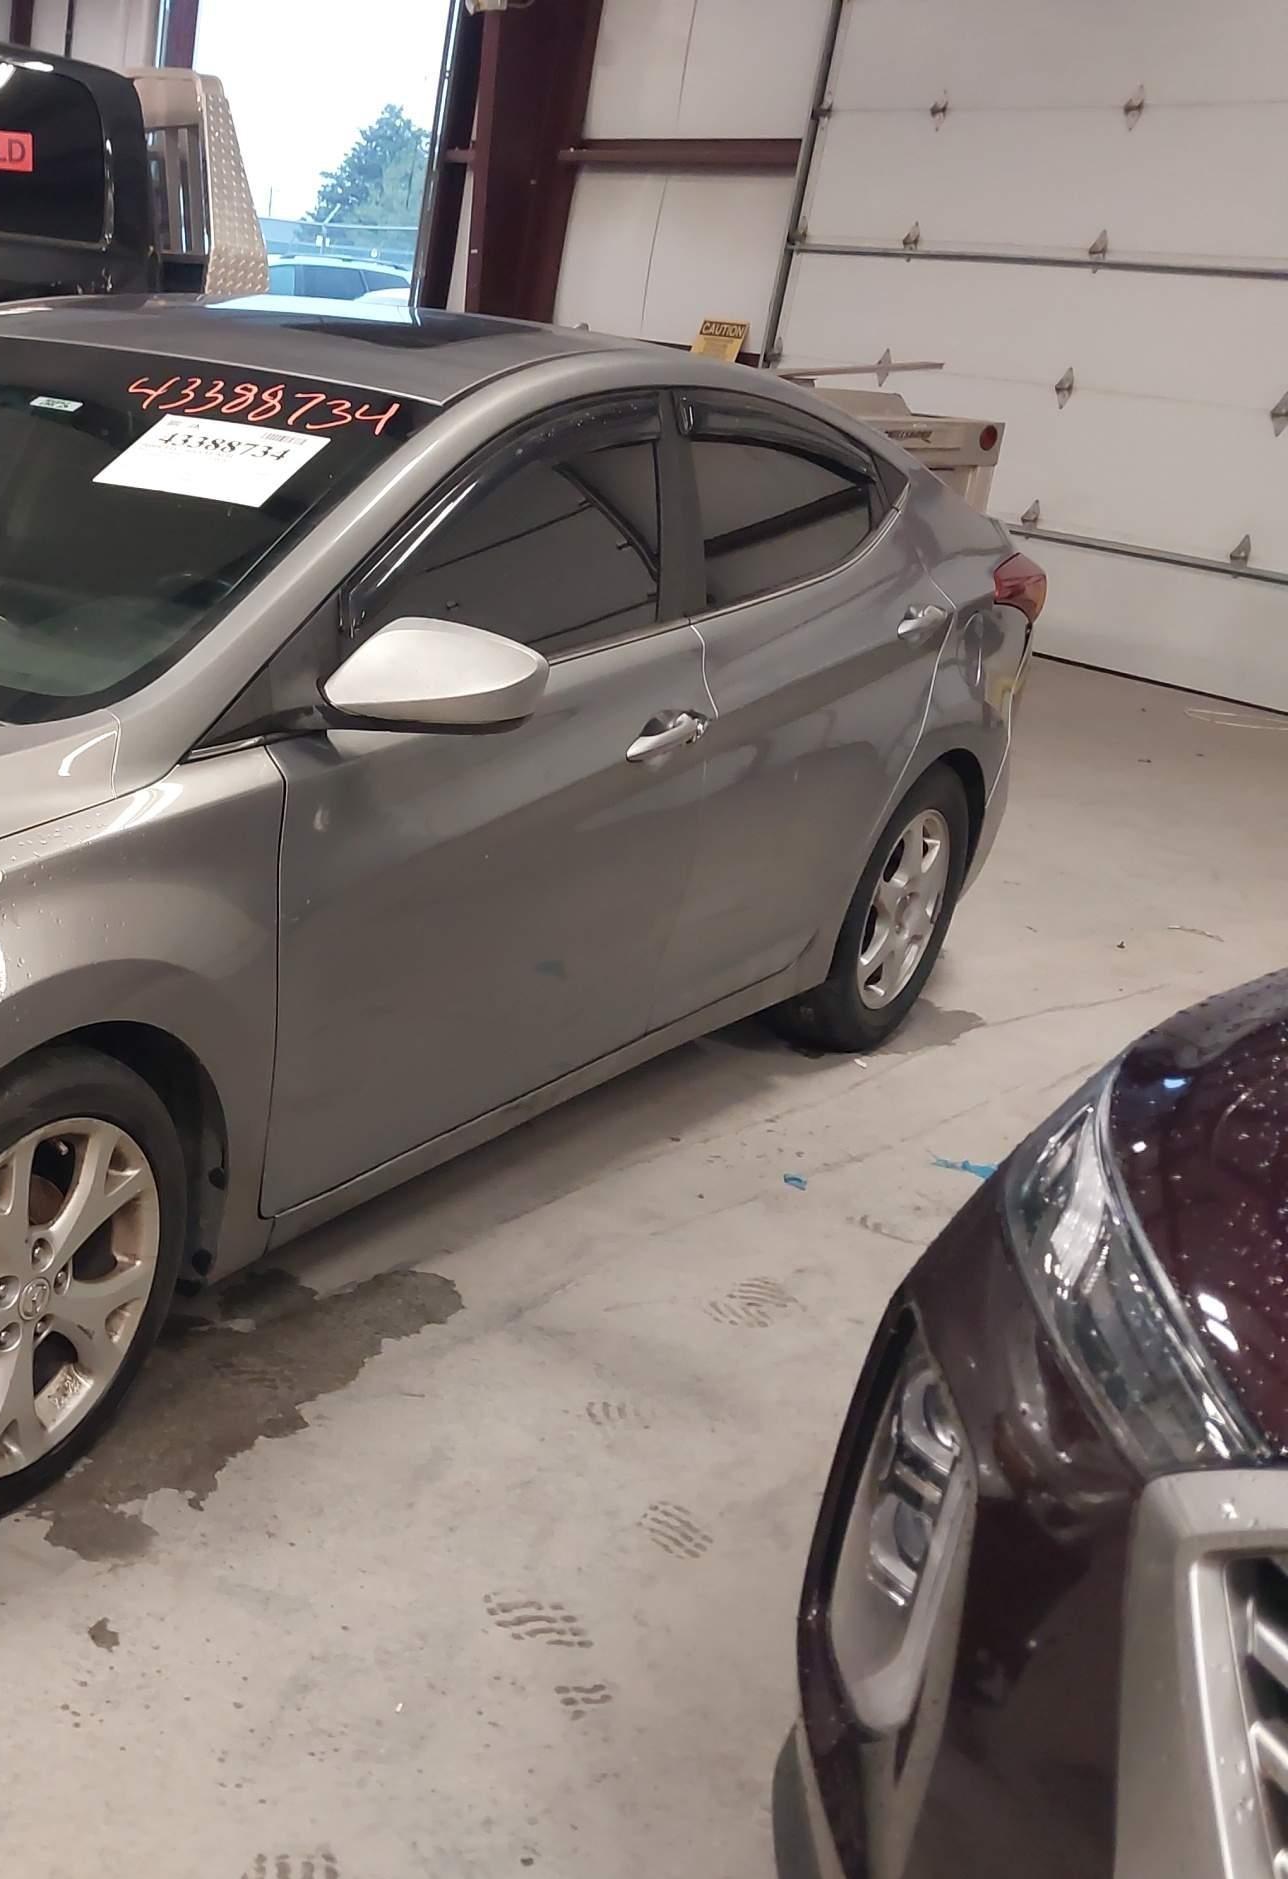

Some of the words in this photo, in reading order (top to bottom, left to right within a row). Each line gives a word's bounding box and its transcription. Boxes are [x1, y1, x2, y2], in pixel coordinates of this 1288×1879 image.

[702, 322, 744, 338] CAUTION
[128, 376, 401, 435] 43388734
[159, 433, 290, 461] 43388734
